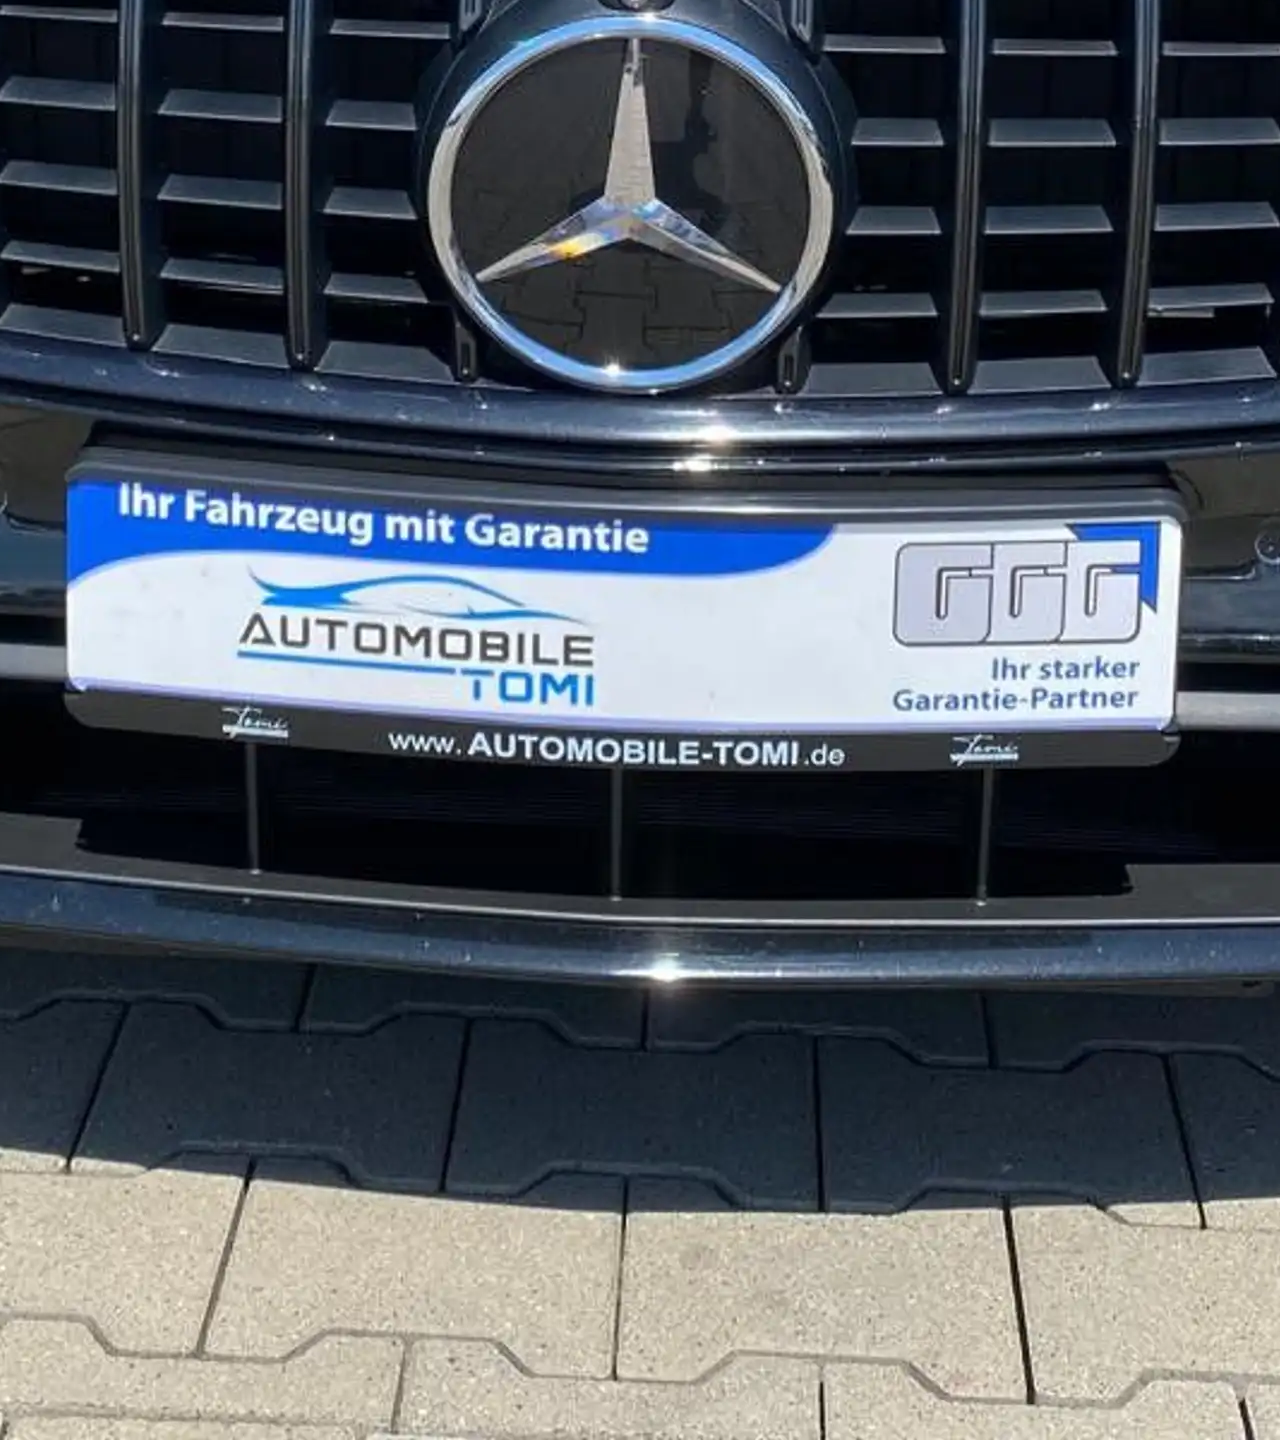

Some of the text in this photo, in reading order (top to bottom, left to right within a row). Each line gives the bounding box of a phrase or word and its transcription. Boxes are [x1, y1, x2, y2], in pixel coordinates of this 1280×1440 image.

[119, 481, 650, 553] Ihr Fahrzeug mit Garantie
[238, 612, 595, 667] AUTOMOBILE
[460, 668, 595, 707] TOMI
[991, 655, 1140, 681] Ihr starker
[893, 687, 1140, 712] Garantie-Partner
